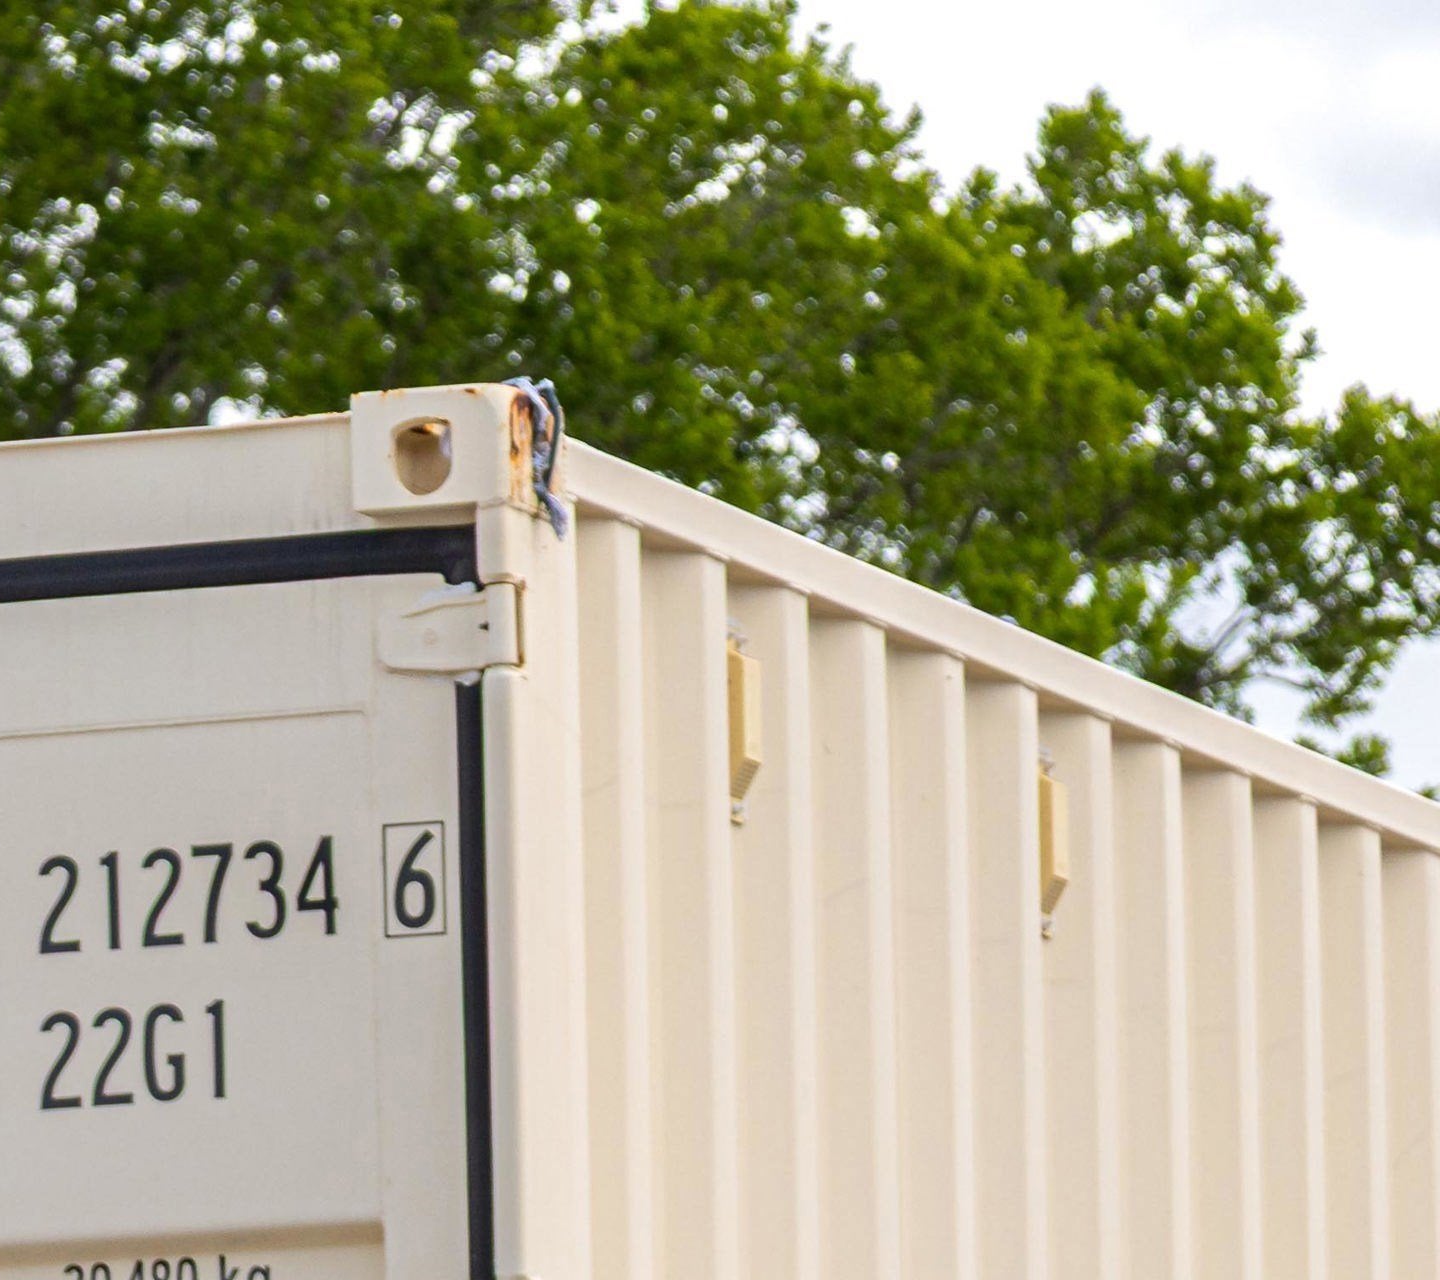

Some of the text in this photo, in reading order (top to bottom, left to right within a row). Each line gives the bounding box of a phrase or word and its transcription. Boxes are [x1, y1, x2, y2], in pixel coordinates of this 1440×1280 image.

[38, 835, 340, 956] 212734
[393, 830, 436, 930] 6
[40, 999, 226, 1111] 22G1
